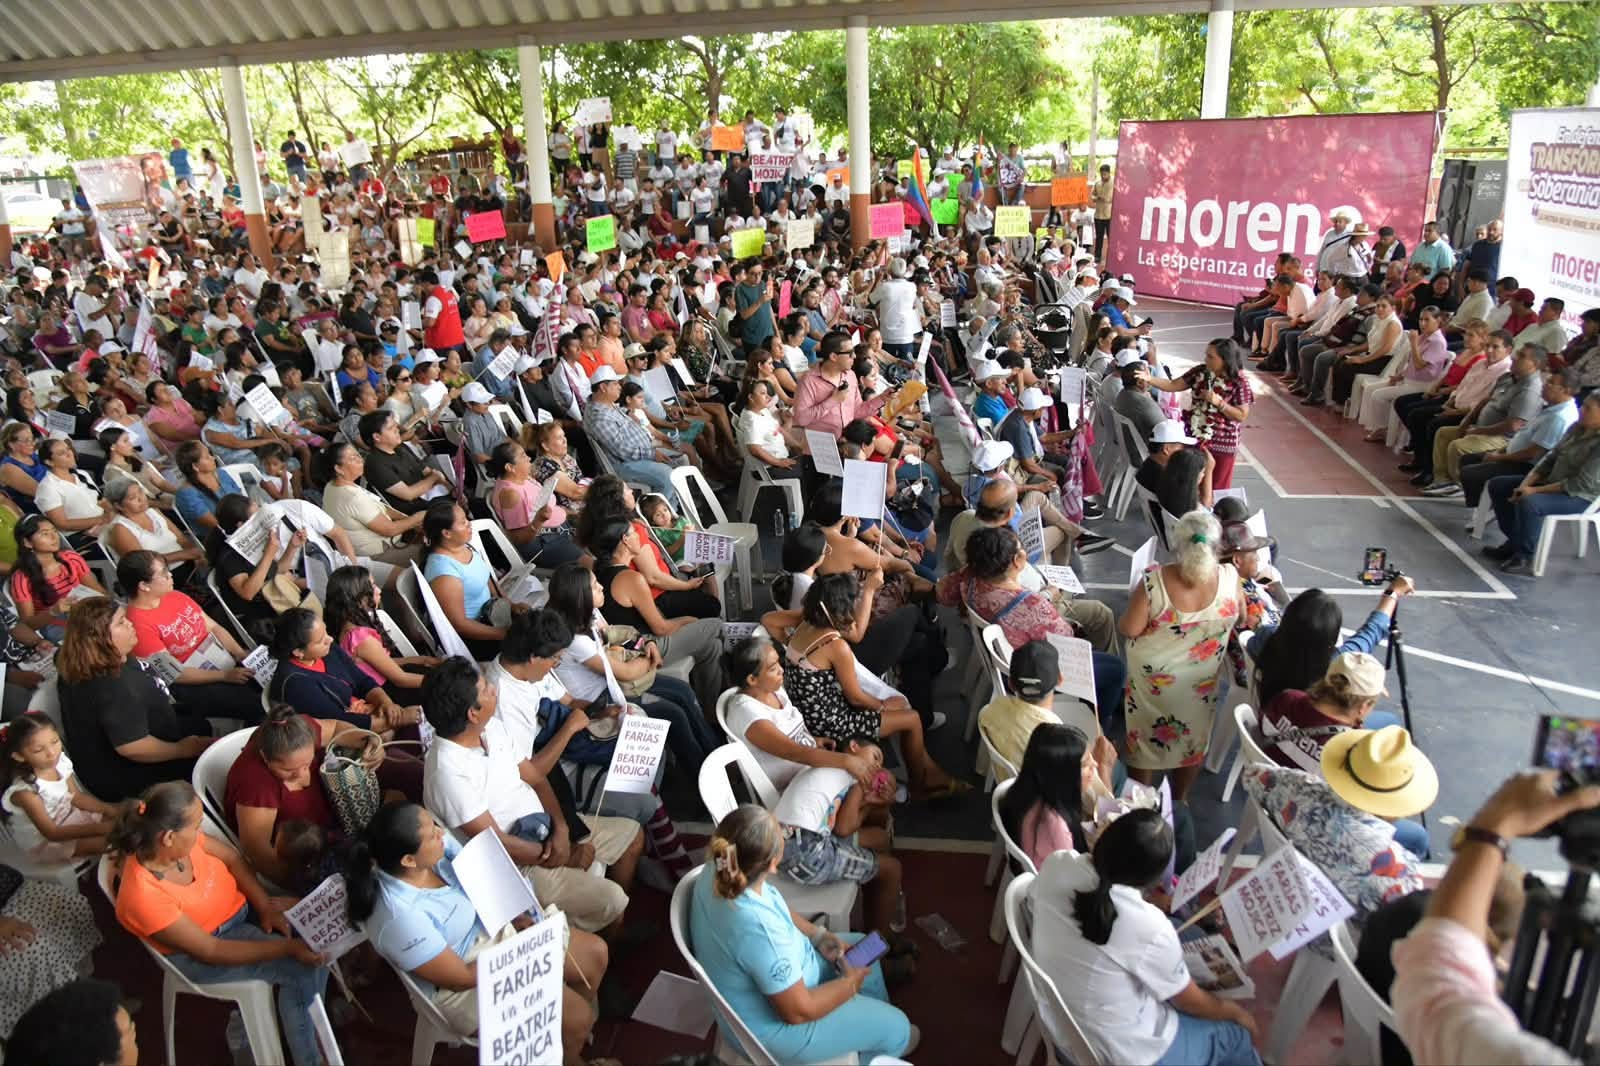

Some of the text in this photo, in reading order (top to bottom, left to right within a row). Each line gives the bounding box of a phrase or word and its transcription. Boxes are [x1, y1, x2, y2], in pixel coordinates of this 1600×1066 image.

[755, 168, 785, 180] MOJIC
[1137, 247, 1156, 266] La
[1160, 253, 1248, 277] esperanza
[613, 765, 650, 777] MOJICA
[617, 753, 657, 767] BEATRIZ
[489, 927, 555, 974] LUIS MIGUEL
[493, 999, 557, 1061] BEATRIZ
[504, 1030, 553, 1066] OJICA
